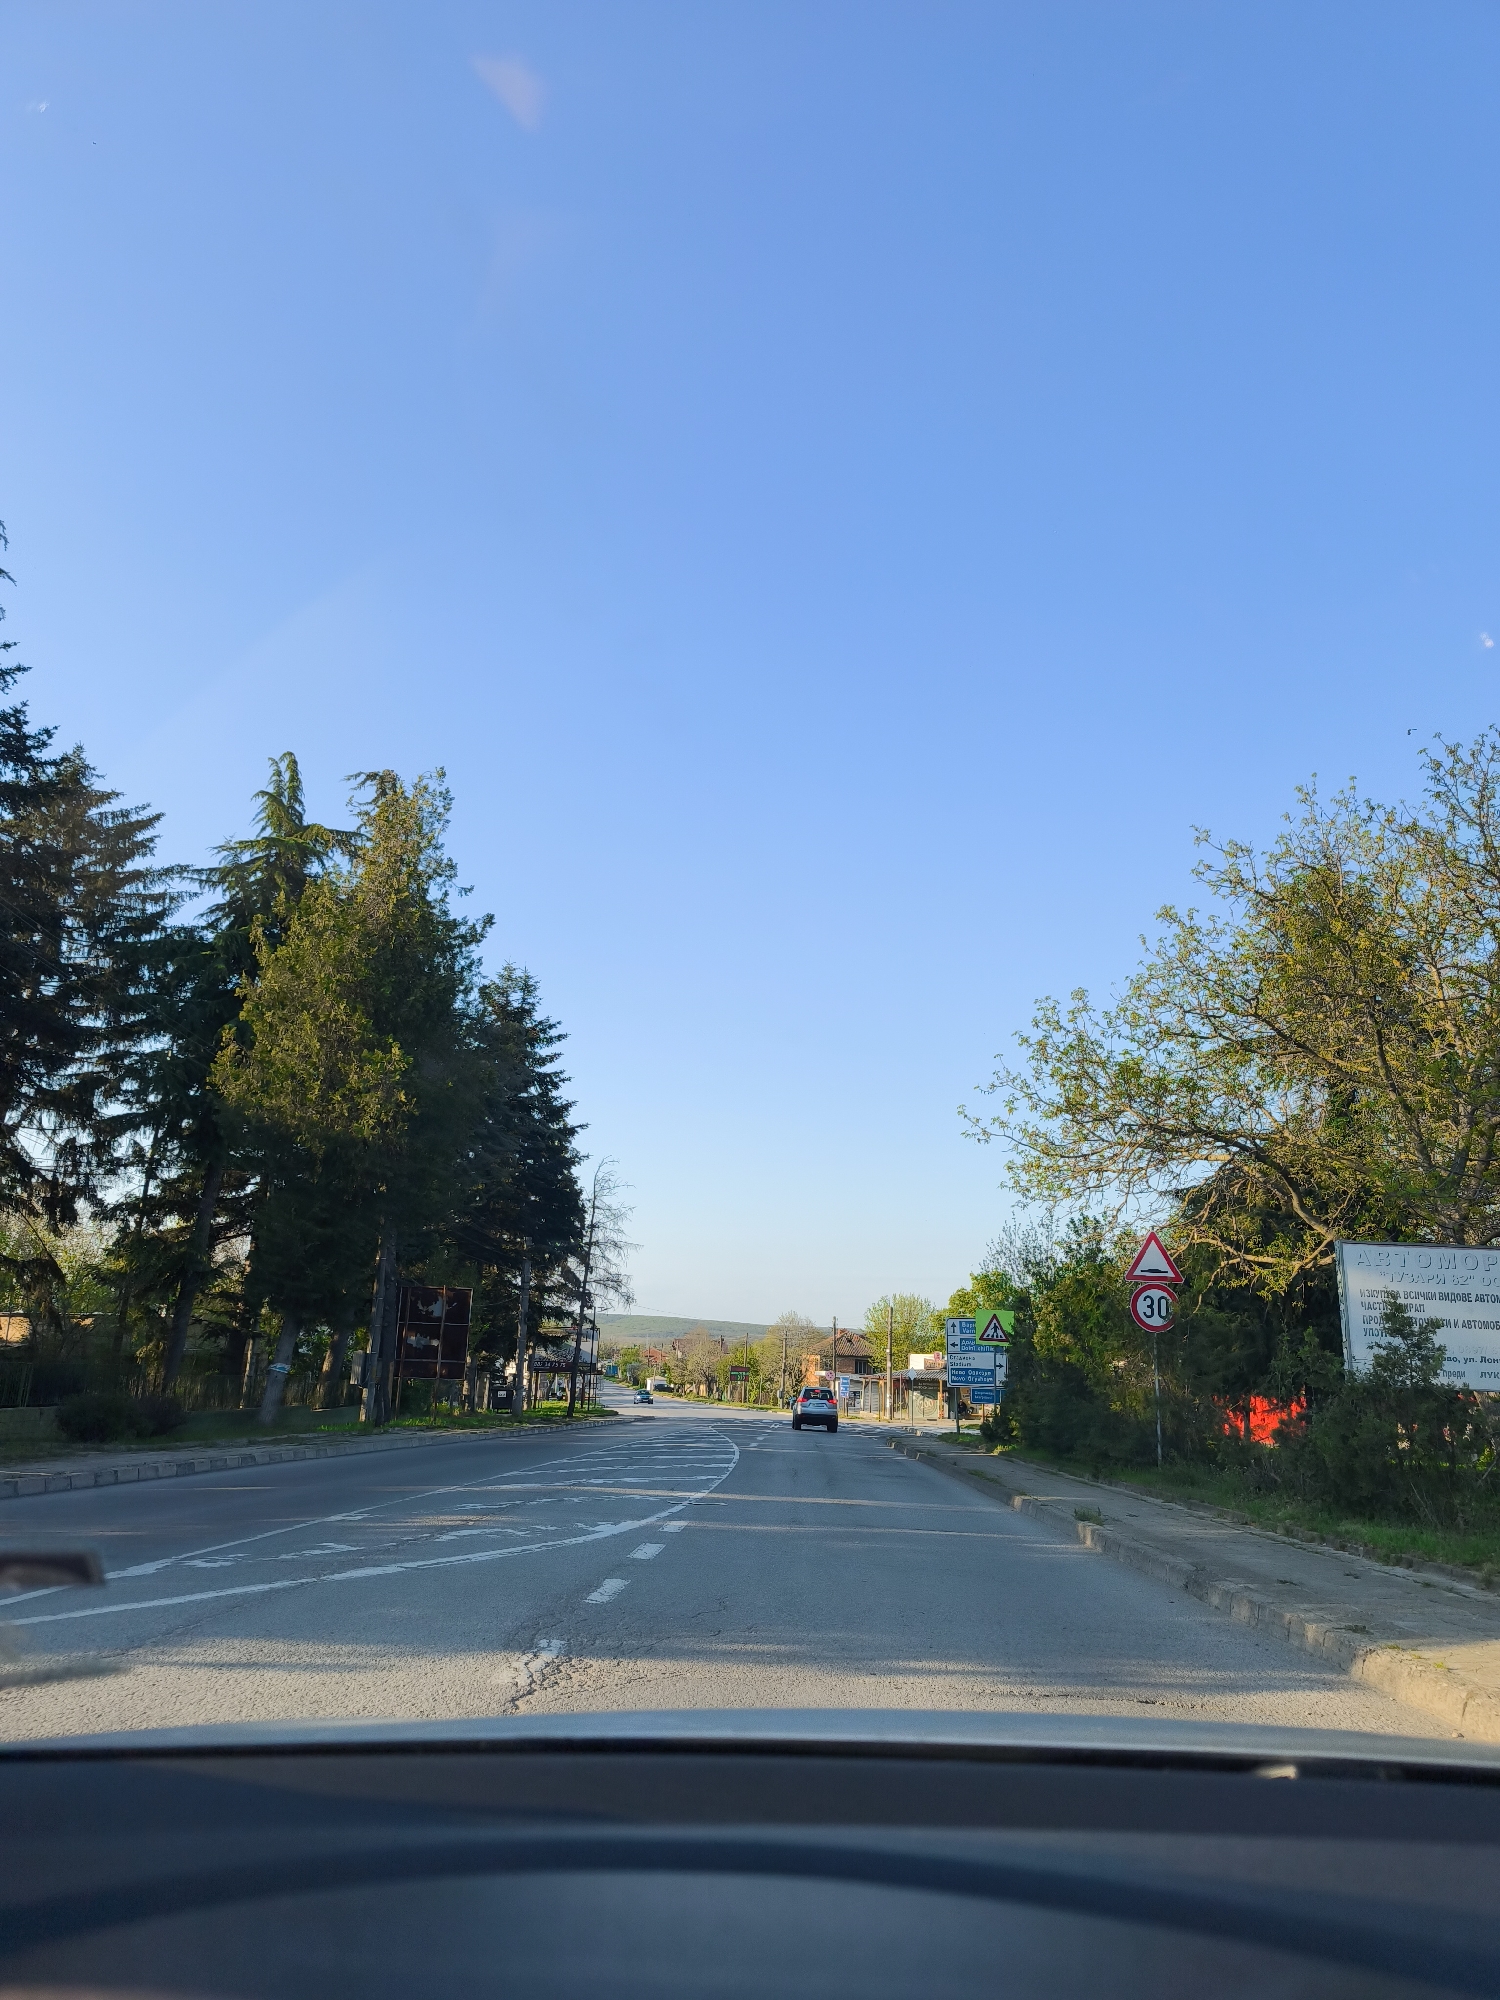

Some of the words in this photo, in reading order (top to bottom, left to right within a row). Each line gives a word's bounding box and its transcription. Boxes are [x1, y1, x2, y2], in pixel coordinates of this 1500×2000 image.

[1403, 1290, 1437, 1301] ВСИЧКИ
[1438, 1292, 1472, 1303] ВИДОВЕ
[1143, 1295, 1169, 1319] 30
